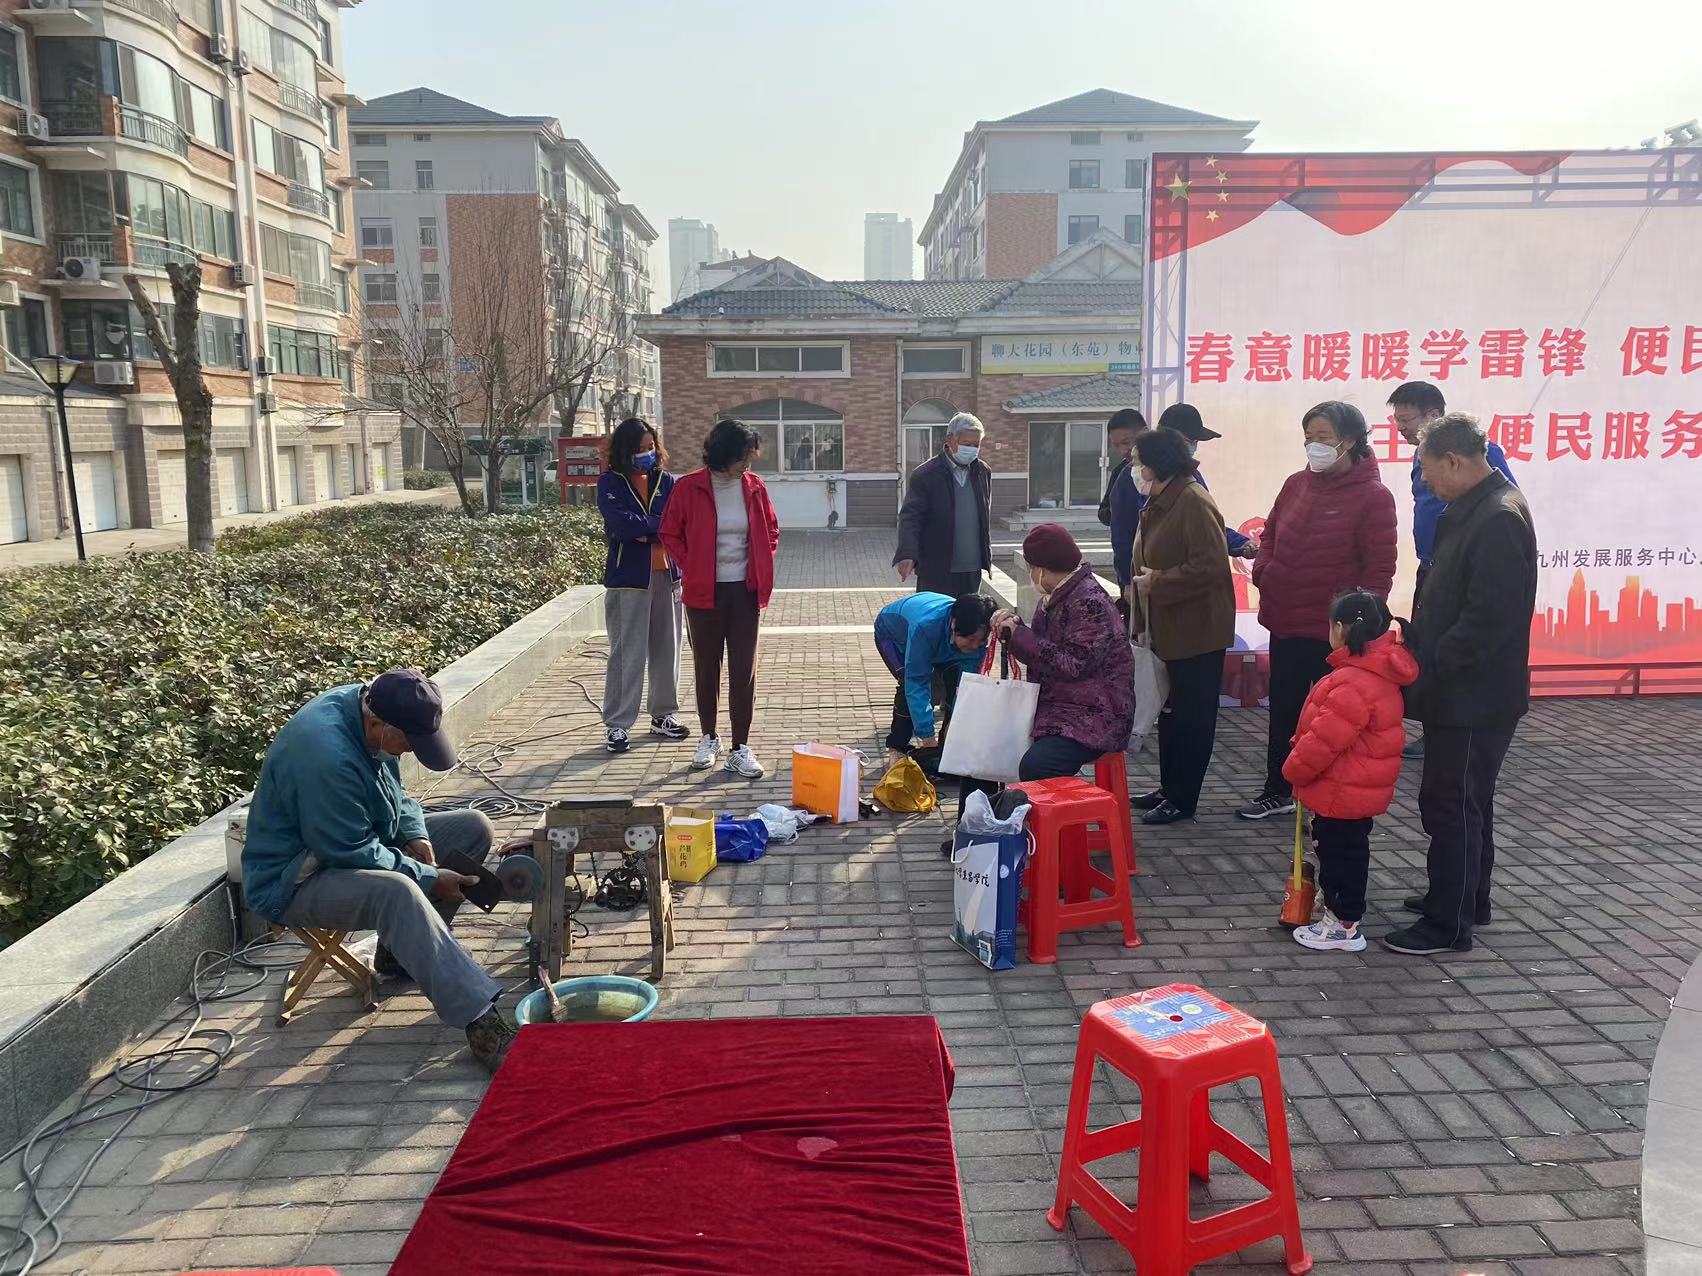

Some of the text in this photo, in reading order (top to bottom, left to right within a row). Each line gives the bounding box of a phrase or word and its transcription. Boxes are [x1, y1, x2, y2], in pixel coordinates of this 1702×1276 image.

[991, 341, 1140, 358] 聊大花园（东苑）物
[1186, 327, 1587, 384] 春意暖暖学雷锋
[1536, 546, 1702, 569] 九州发展服务中心
